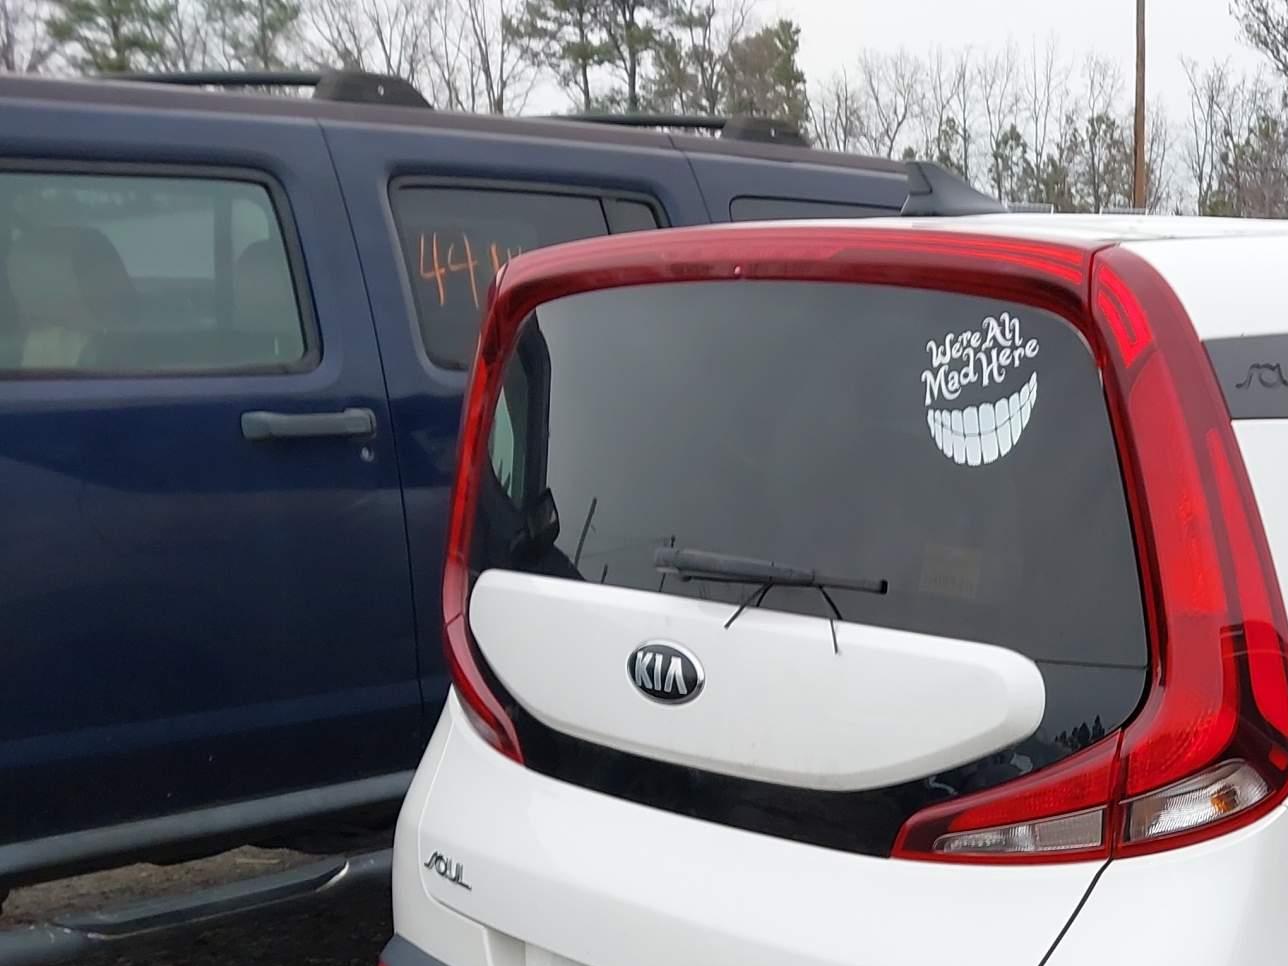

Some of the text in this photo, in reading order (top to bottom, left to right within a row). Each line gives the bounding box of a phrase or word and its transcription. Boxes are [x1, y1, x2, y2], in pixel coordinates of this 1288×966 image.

[921, 338, 1040, 407] Mad Here
[634, 650, 688, 695] KIA
